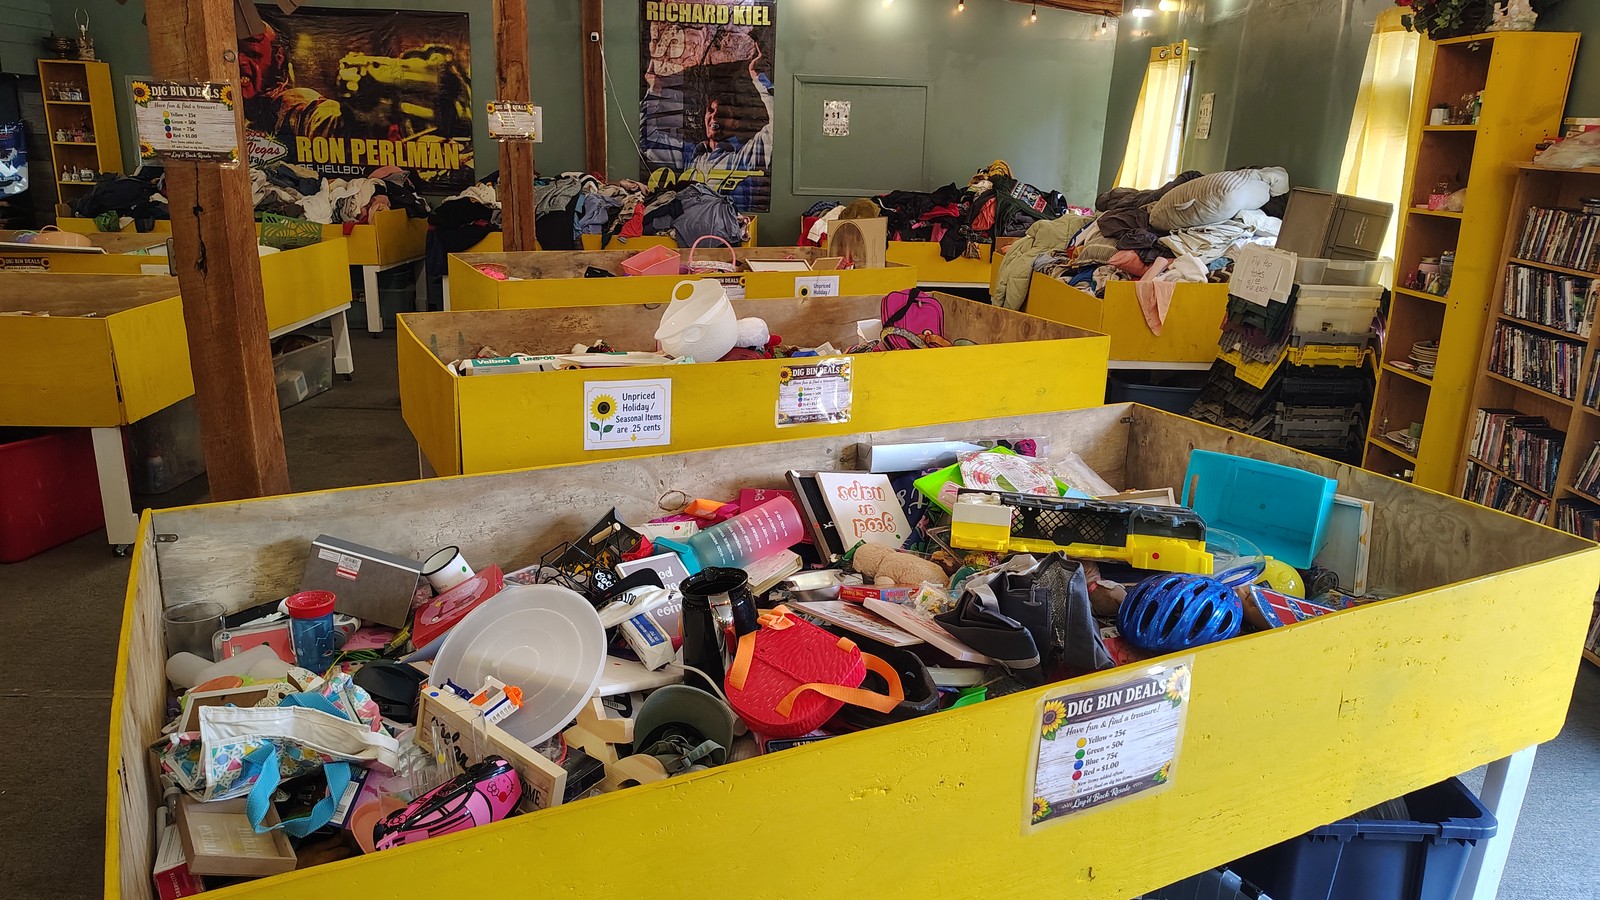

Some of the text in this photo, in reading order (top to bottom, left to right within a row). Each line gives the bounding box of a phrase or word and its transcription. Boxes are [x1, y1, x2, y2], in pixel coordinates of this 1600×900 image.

[646, 2, 772, 26] RICHARD KIEL
[151, 86, 168, 96] DIG
[170, 86, 188, 96] BIN
[247, 141, 280, 158] Vegas
[296, 136, 460, 170] RON PERLMAN
[317, 164, 366, 175] HELLBOY
[793, 368, 805, 377] DIG
[806, 367, 818, 376] BIN
[622, 391, 656, 402] Unpriced
[622, 403, 649, 412] Holiday
[616, 414, 643, 423] Seasonal
[630, 424, 641, 433] .25
[837, 480, 886, 501] naps
[852, 512, 896, 538] good
[1066, 679, 1167, 718] DIG BIN DEALS
[1066, 726, 1085, 736] Have
[1086, 722, 1099, 734] fun
[1108, 715, 1123, 728] find
[1130, 704, 1161, 720] treasure!
[1088, 734, 1108, 744] Yellow
[1114, 729, 1127, 738] 25¢
[1086, 747, 1104, 756] Green
[1111, 740, 1124, 749] 50¢
[1085, 757, 1099, 766] Blue
[1106, 752, 1119, 760] 75¢
[1083, 768, 1095, 777] Red
[1101, 761, 1119, 771] $1.00
[520, 780, 541, 806] OME
[1071, 784, 1131, 809] Lay'd Back Resale
[198, 824, 224, 854] exhal
